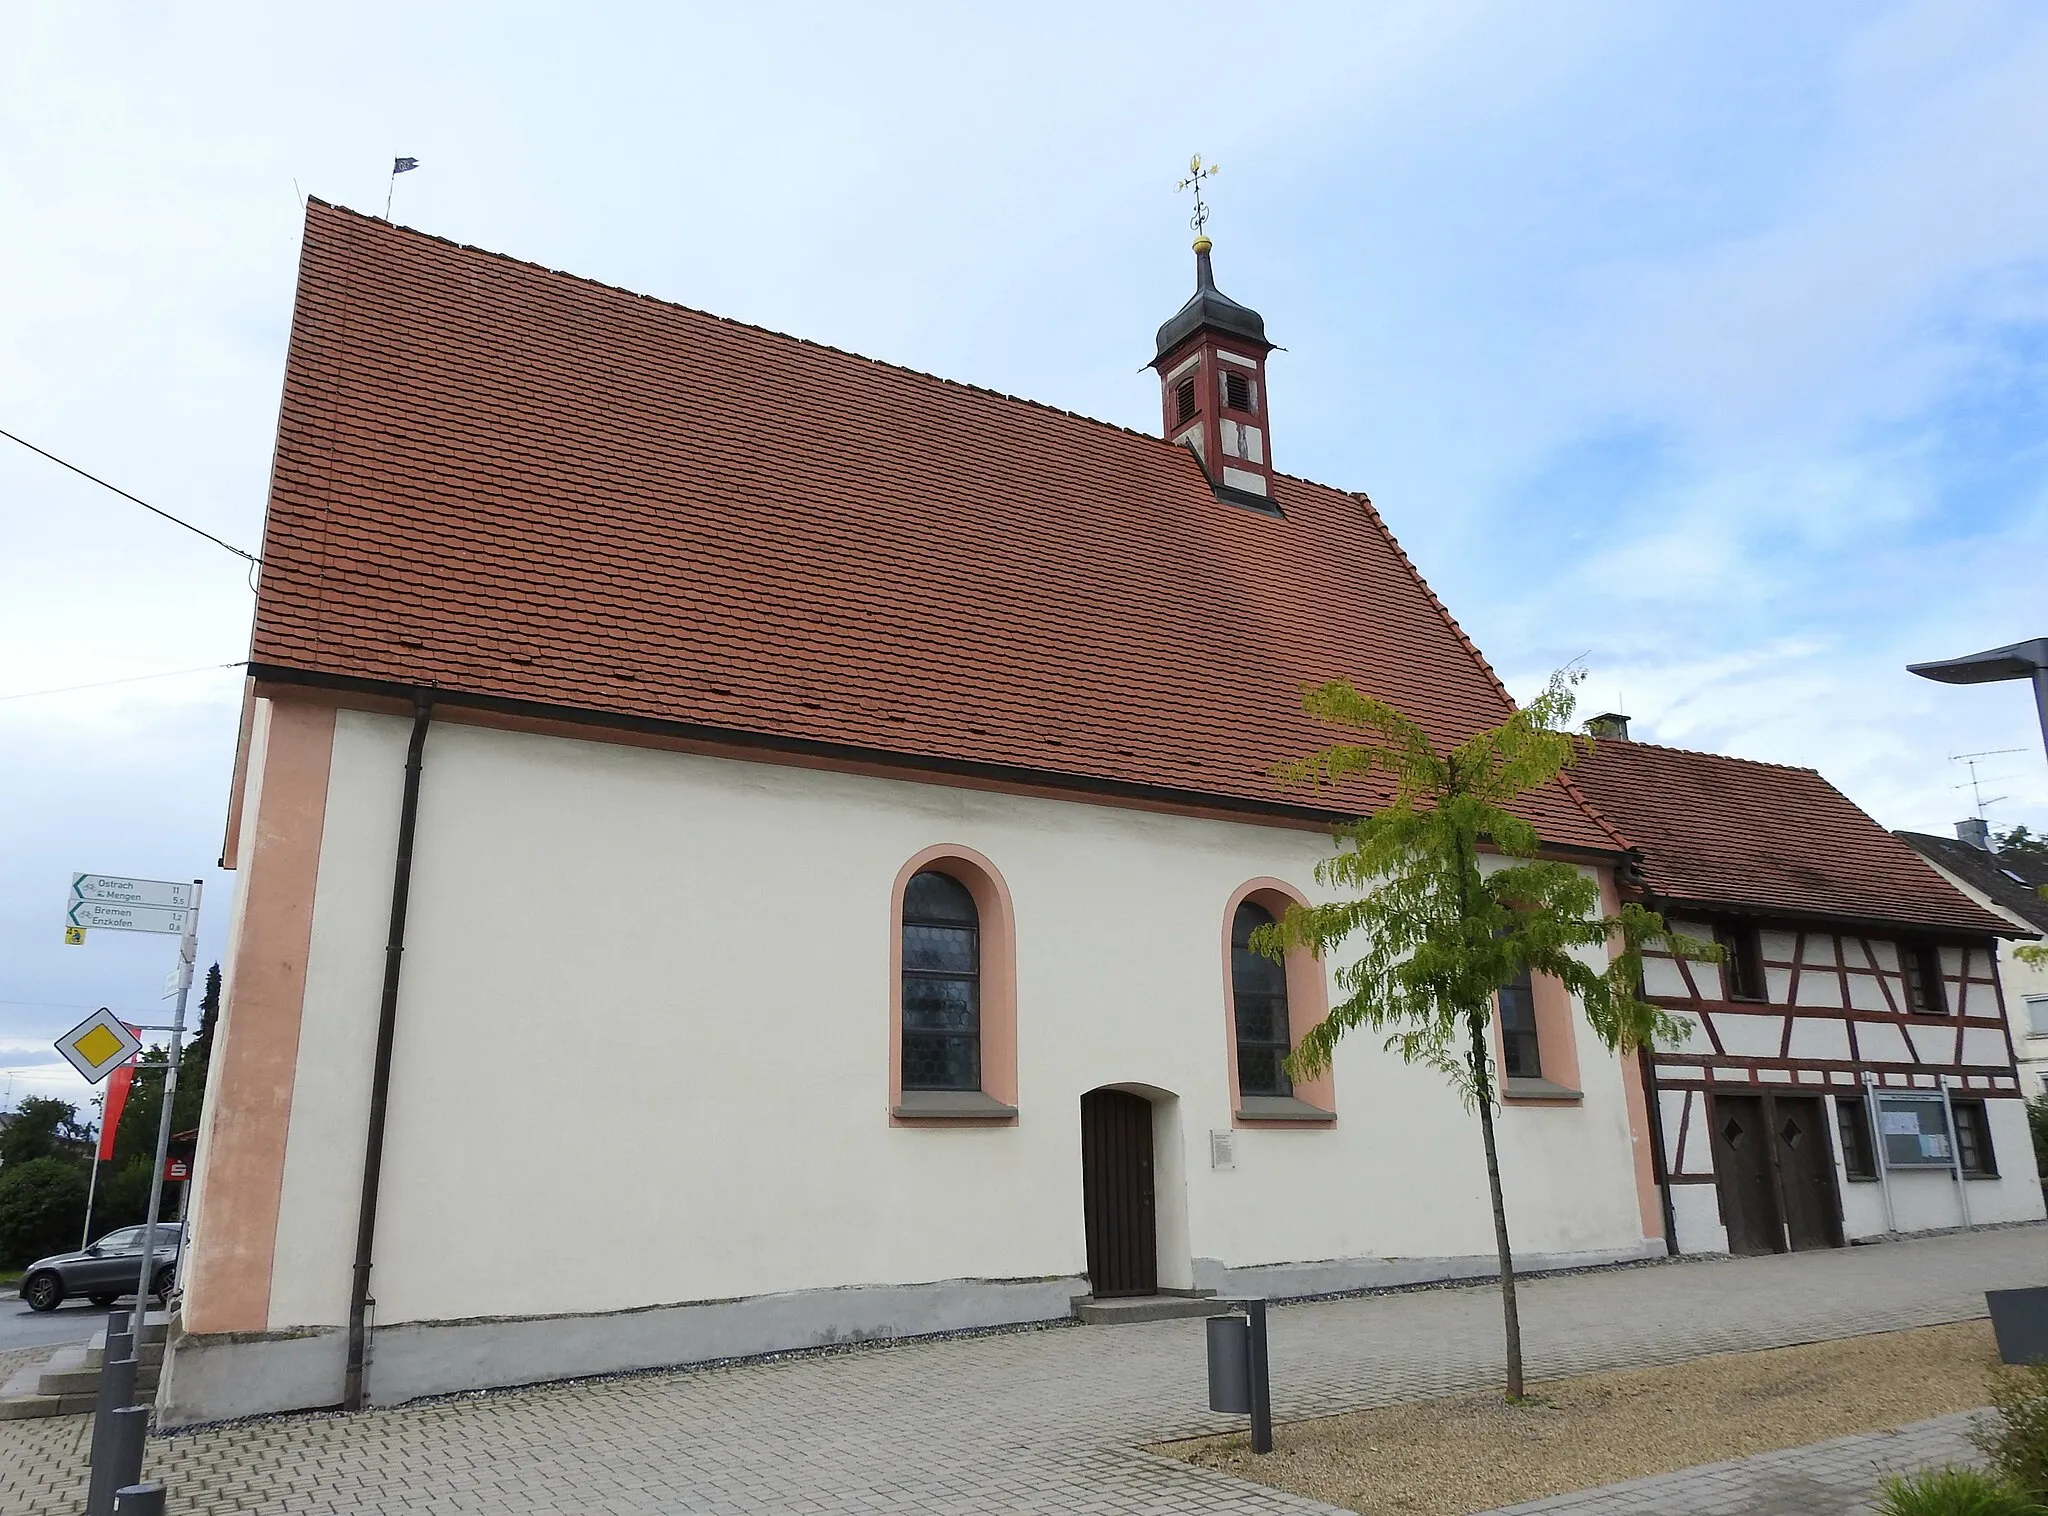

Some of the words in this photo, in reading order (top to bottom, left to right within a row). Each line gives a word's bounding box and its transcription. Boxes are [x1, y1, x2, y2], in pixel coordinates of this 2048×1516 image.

[98, 879, 134, 889] Ostrach
[173, 886, 180, 894] 11
[106, 890, 141, 901] Mengen
[94, 906, 132, 916] Bremen
[173, 913, 182, 921] 1,2
[92, 917, 133, 927] Enzkofen
